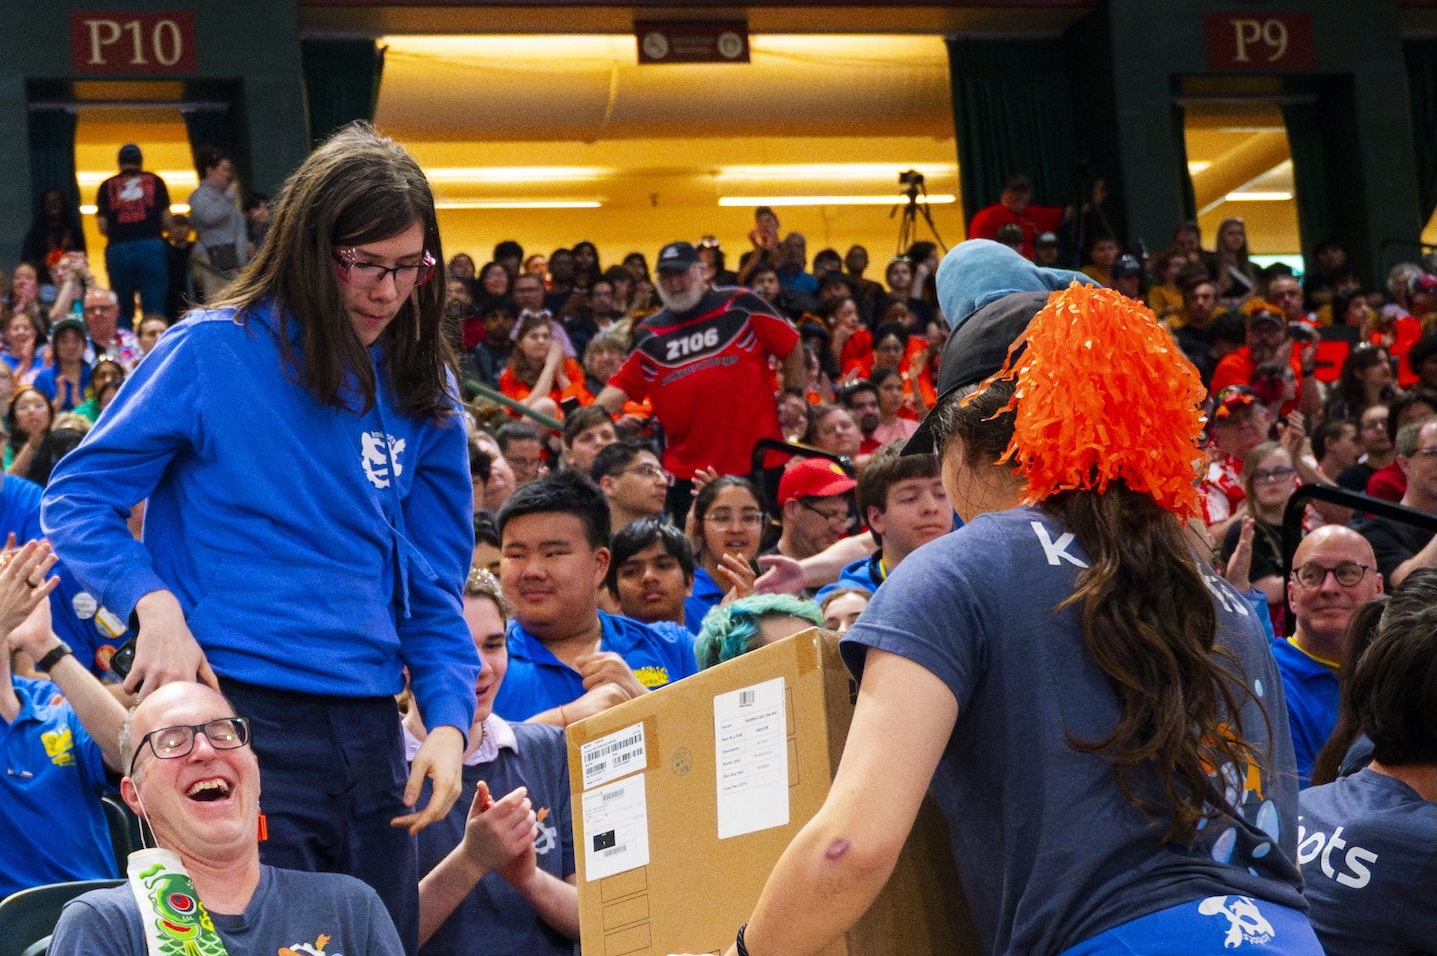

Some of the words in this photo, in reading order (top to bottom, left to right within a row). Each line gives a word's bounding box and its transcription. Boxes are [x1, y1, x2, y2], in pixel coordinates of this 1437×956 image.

[83, 19, 182, 65] P10
[1230, 19, 1288, 62] P9
[665, 326, 720, 361] 2106
[1297, 815, 1379, 889] ots
